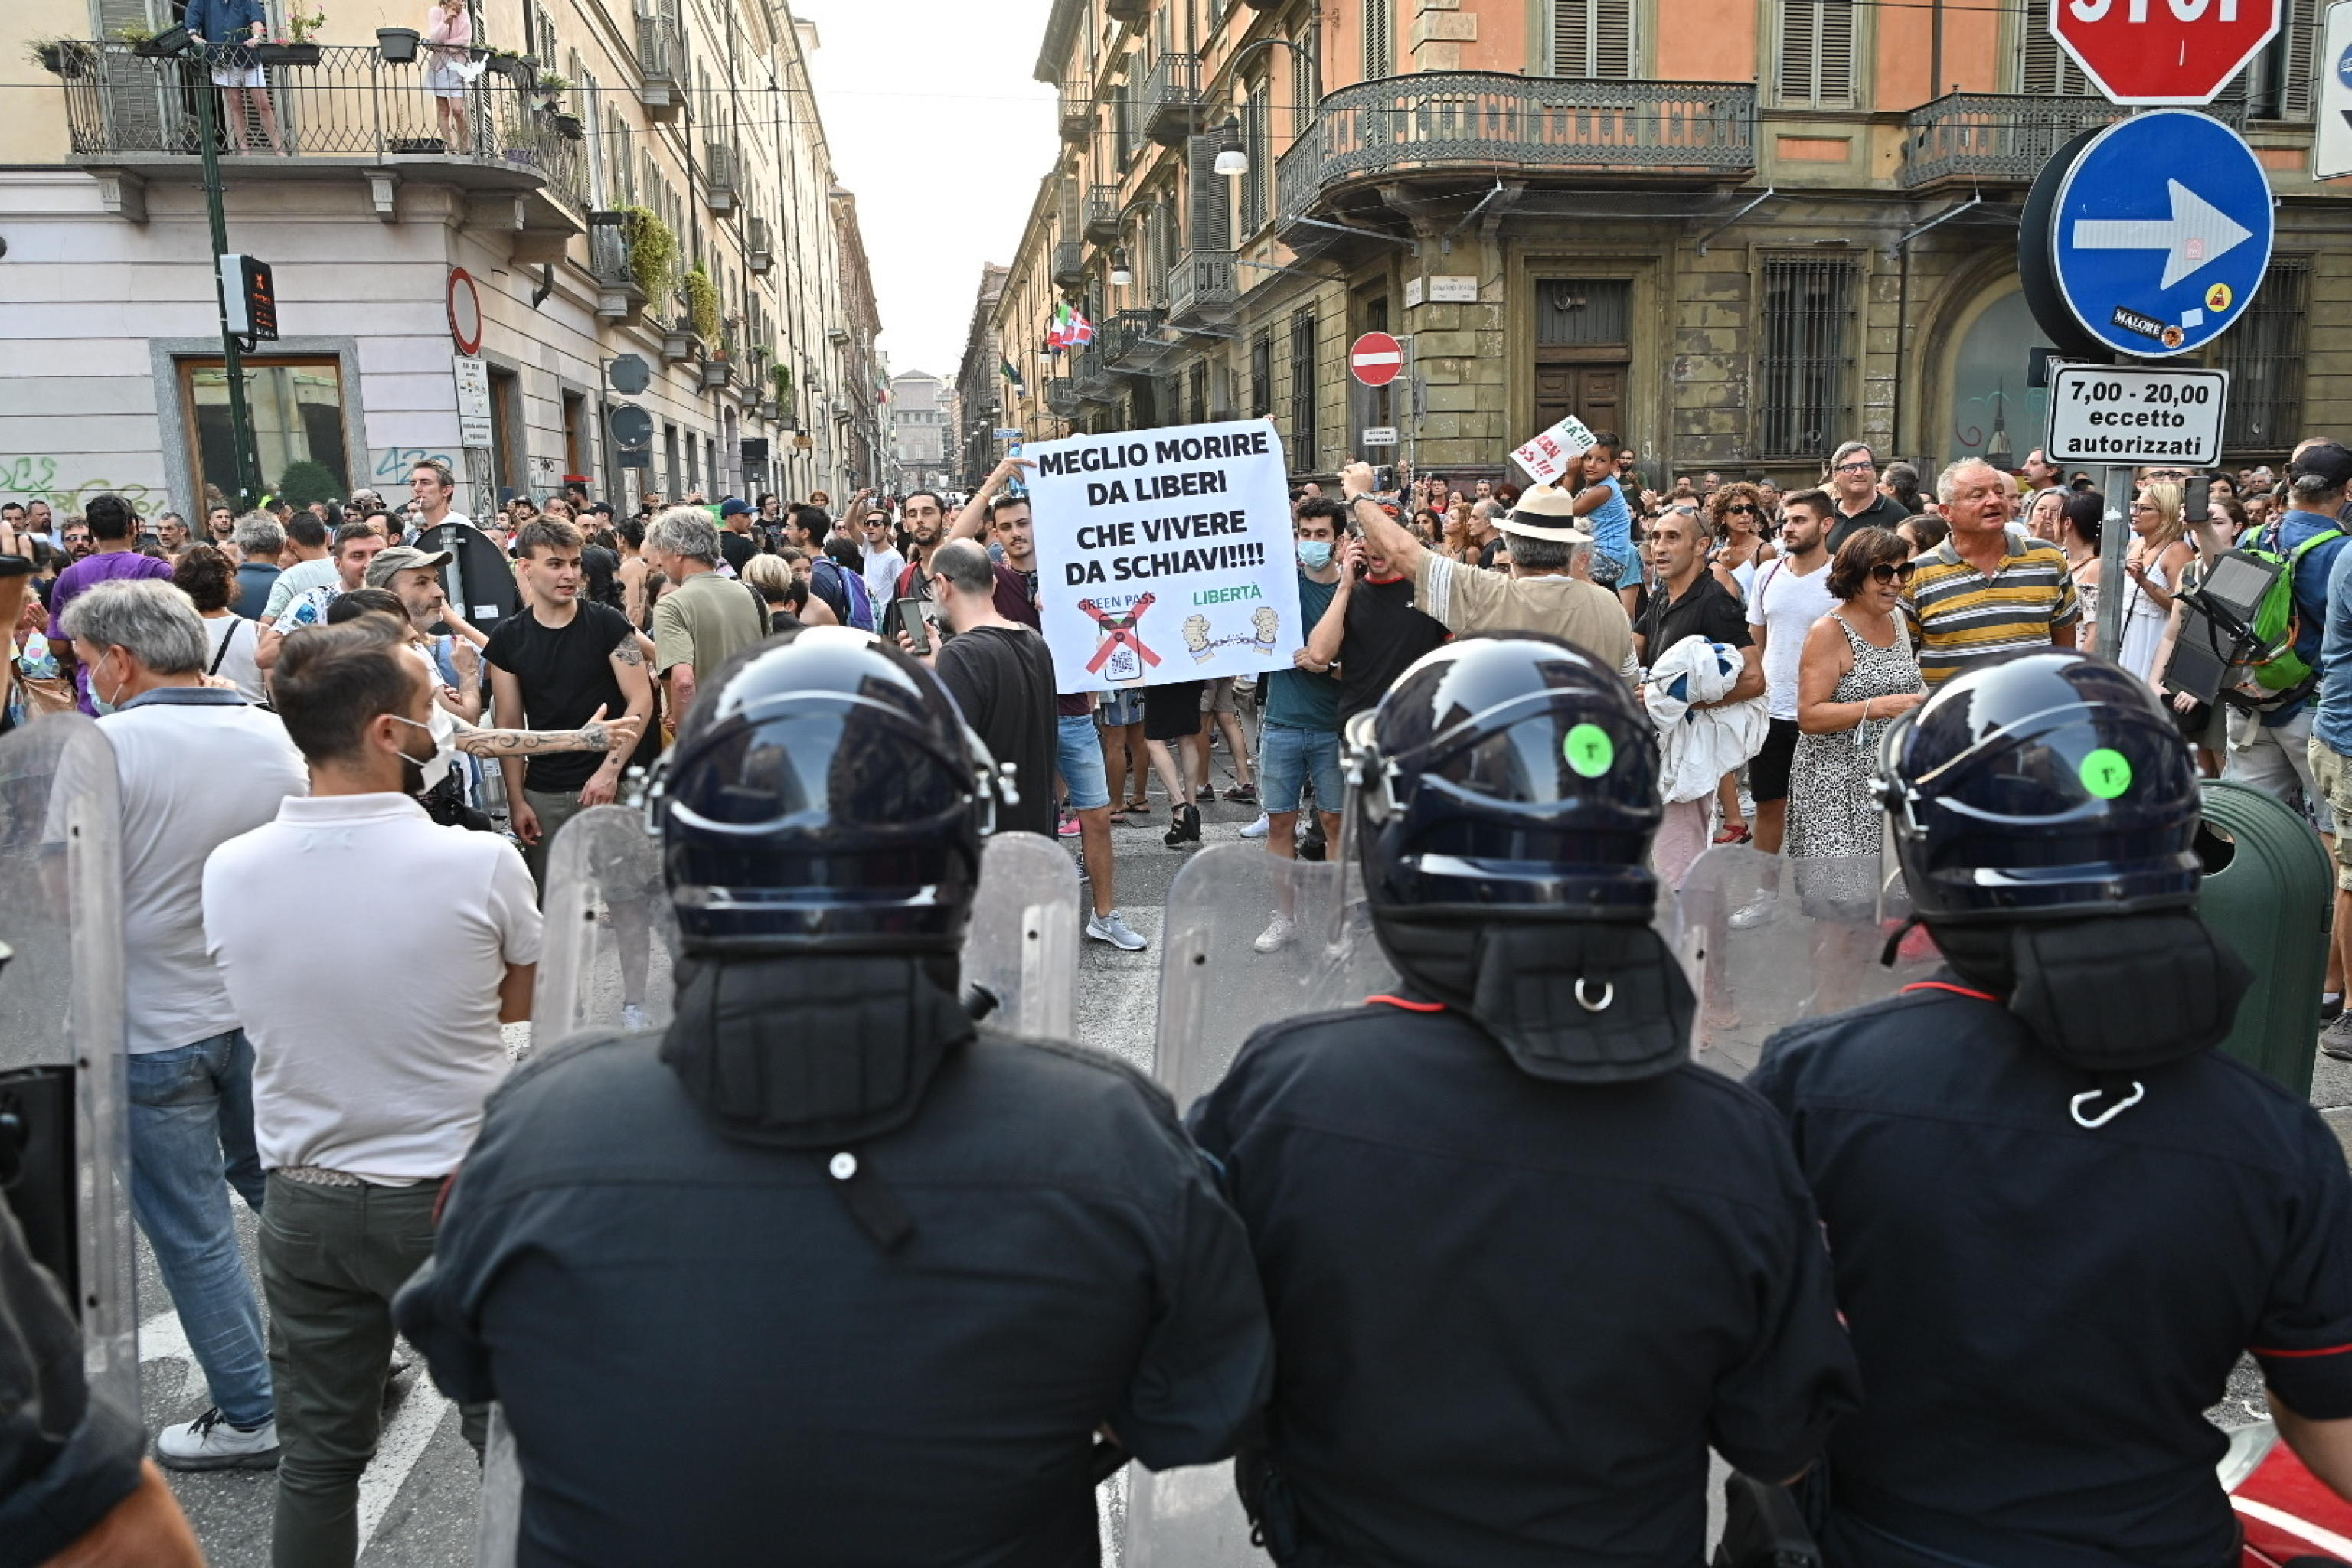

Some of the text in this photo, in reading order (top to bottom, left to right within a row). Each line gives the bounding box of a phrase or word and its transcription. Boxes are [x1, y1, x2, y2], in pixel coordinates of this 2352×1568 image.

[2071, 381, 2122, 405] 7,00
[2143, 384, 2209, 407] 20,00
[2089, 410, 2184, 427] eccetto
[1038, 431, 1269, 477] MEGLIO MORIRE
[2067, 435, 2201, 455] autorizzati
[1087, 470, 1227, 506] DA LIBERI
[1076, 510, 1247, 550] CHE VIVERE
[1065, 542, 1265, 586] DA SCHIAVI!!!!
[1078, 591, 1156, 611] GREEN PASS
[1193, 582, 1263, 606] LIBERTÀ
